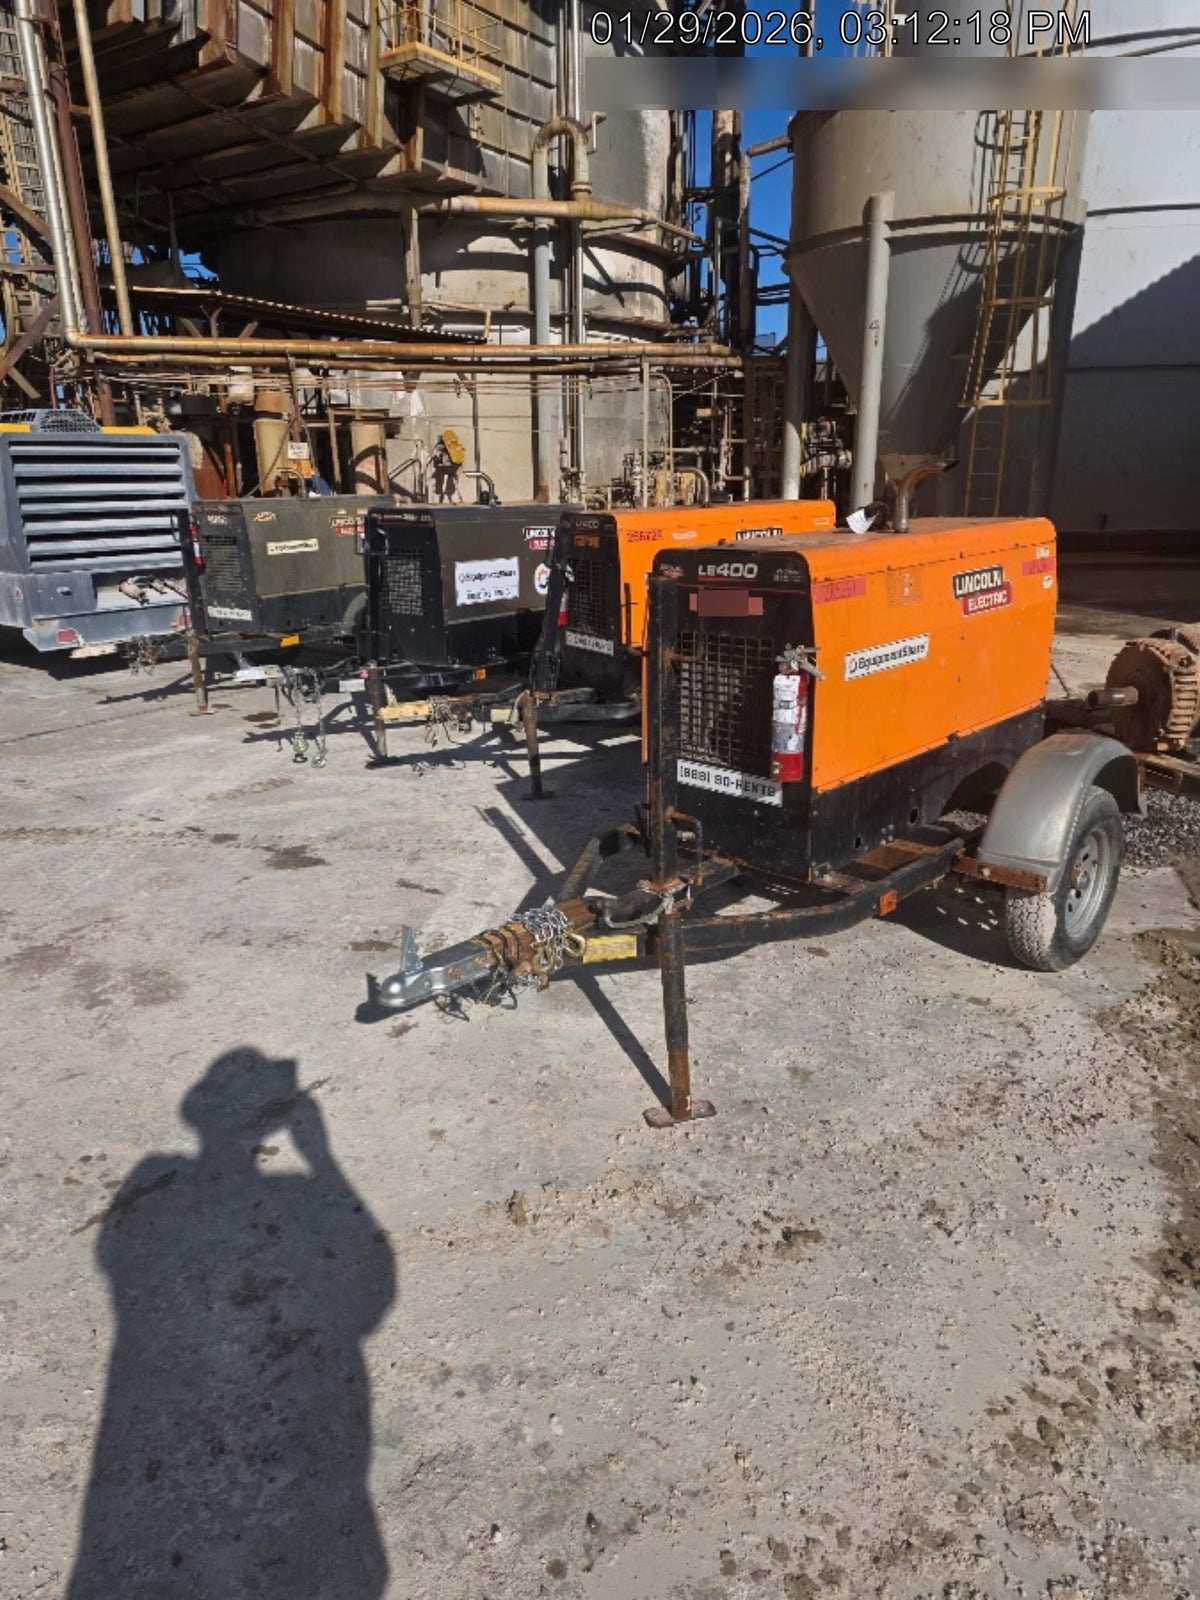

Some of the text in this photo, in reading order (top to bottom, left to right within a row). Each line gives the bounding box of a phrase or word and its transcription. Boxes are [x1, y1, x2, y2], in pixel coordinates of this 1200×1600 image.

[698, 563, 758, 579] LE400
[955, 569, 1002, 596] LINCOLN
[967, 590, 1008, 612] ELECTRIC
